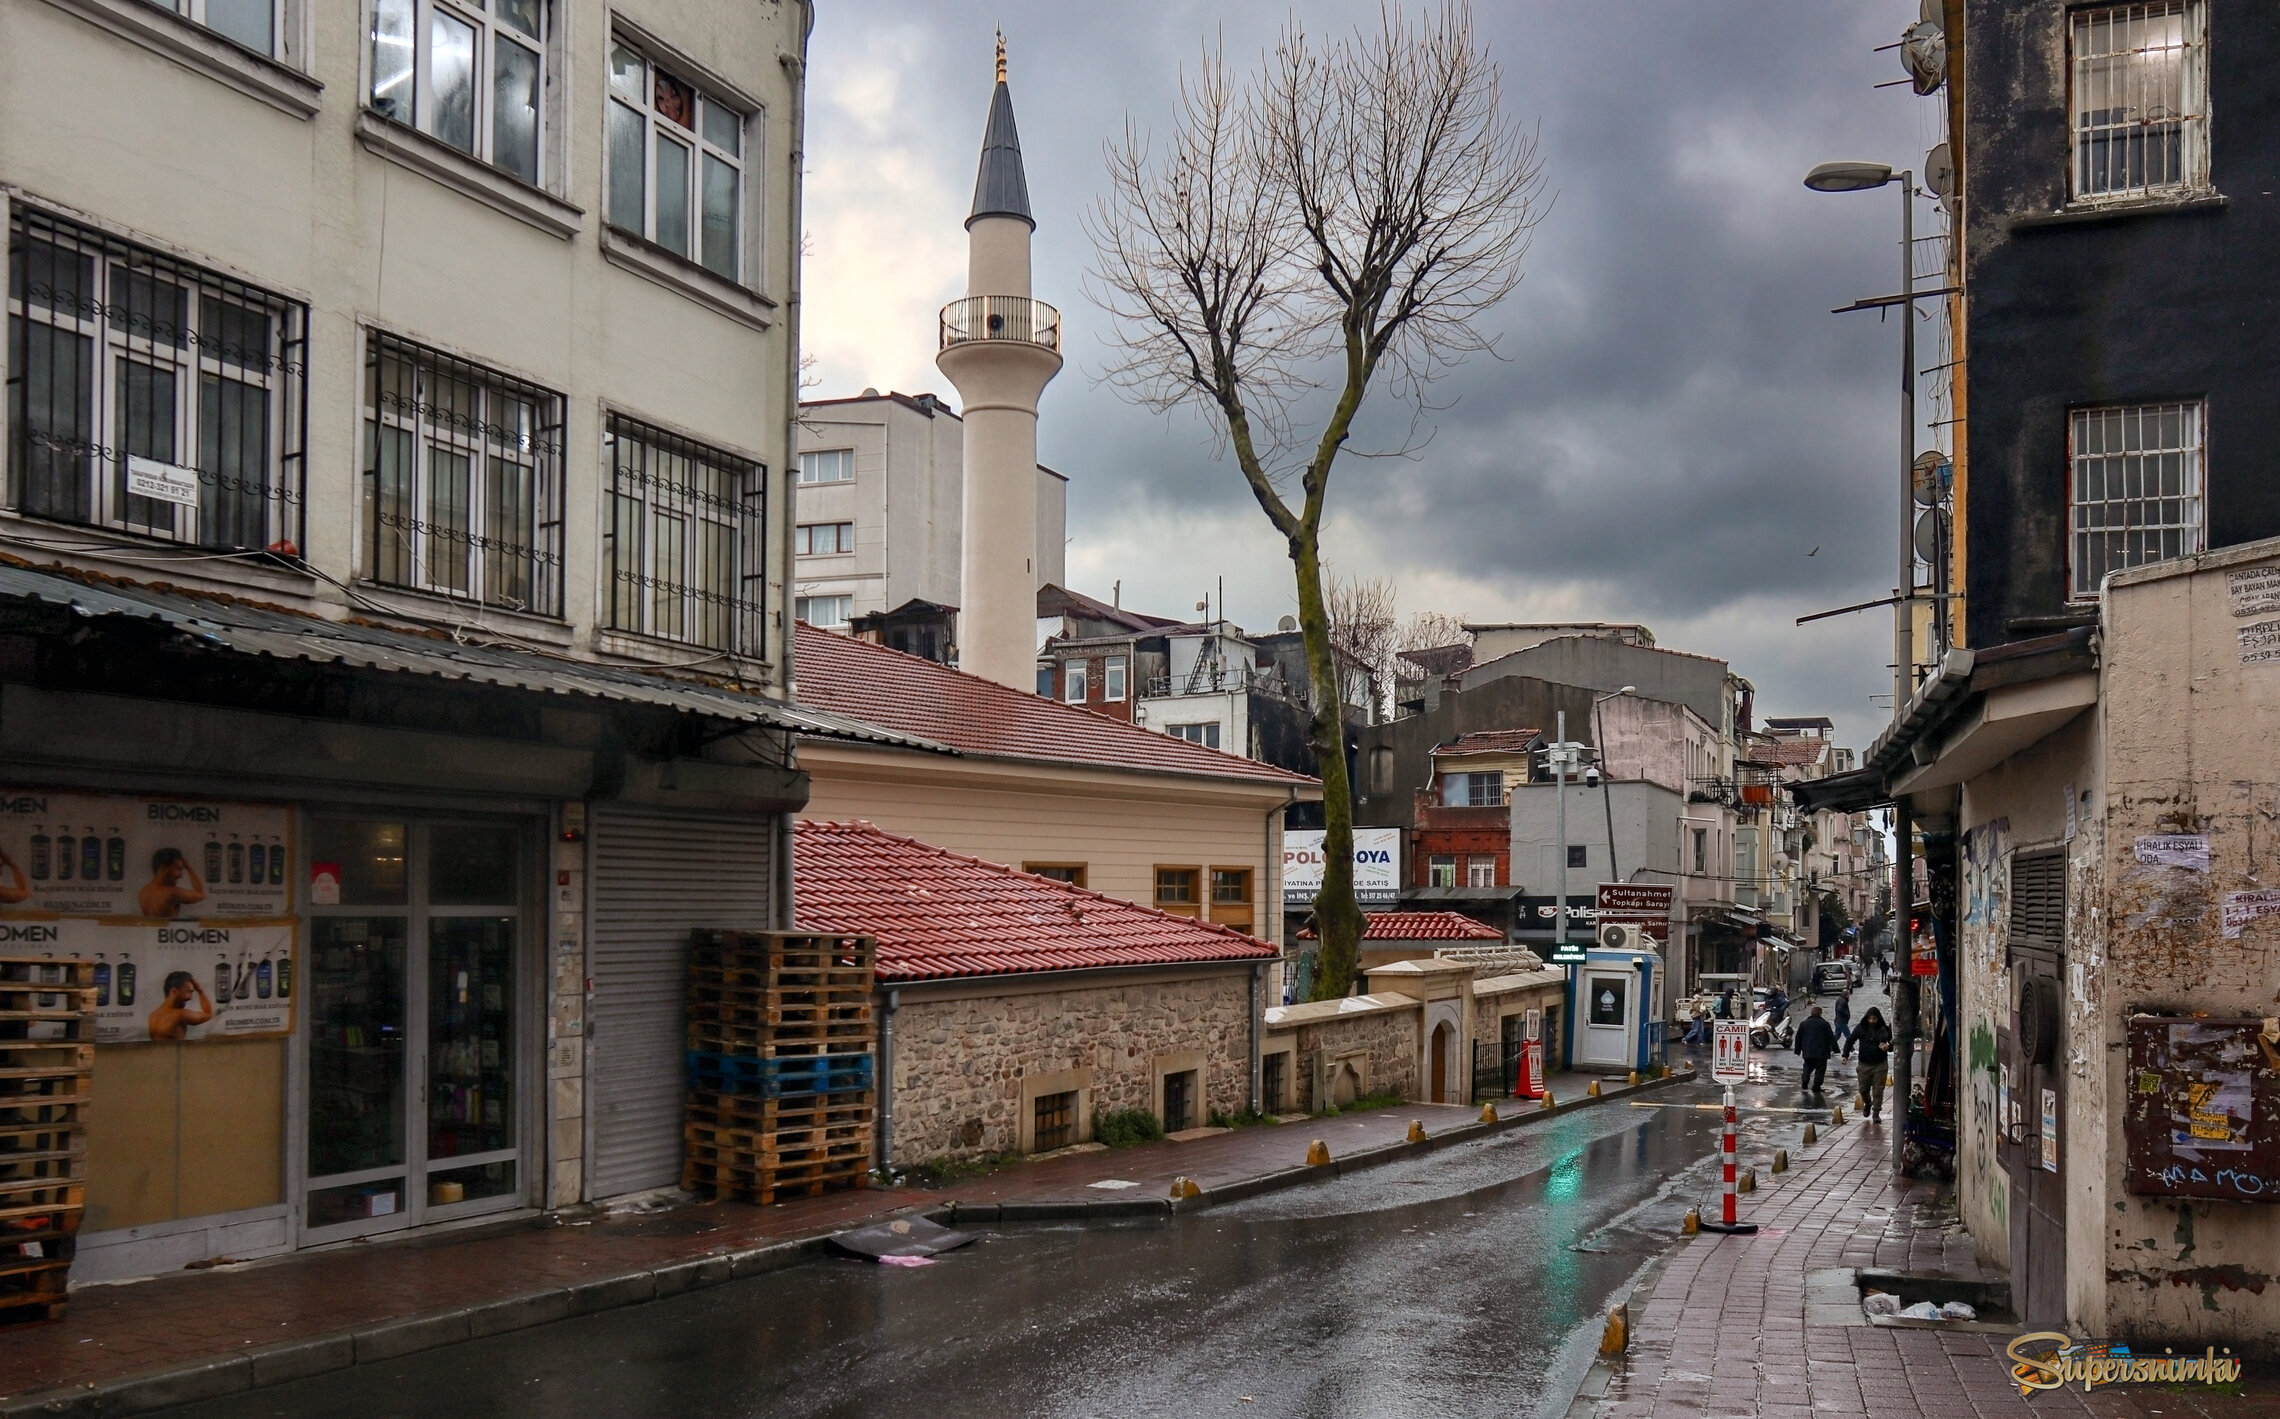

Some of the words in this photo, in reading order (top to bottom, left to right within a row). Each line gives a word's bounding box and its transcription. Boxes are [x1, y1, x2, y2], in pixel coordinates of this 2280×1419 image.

[148, 803, 220, 823] BIOMEN
[2136, 839, 2171, 851] KİRALIK
[2173, 841, 2203, 853] EŞYALI
[1352, 850, 1391, 864] OYA
[1612, 889, 1671, 898] Sultanahmet
[1612, 899, 1643, 907] Topkapı
[1645, 900, 1670, 909] Sarayı
[157, 928, 230, 943] BIOMEN
